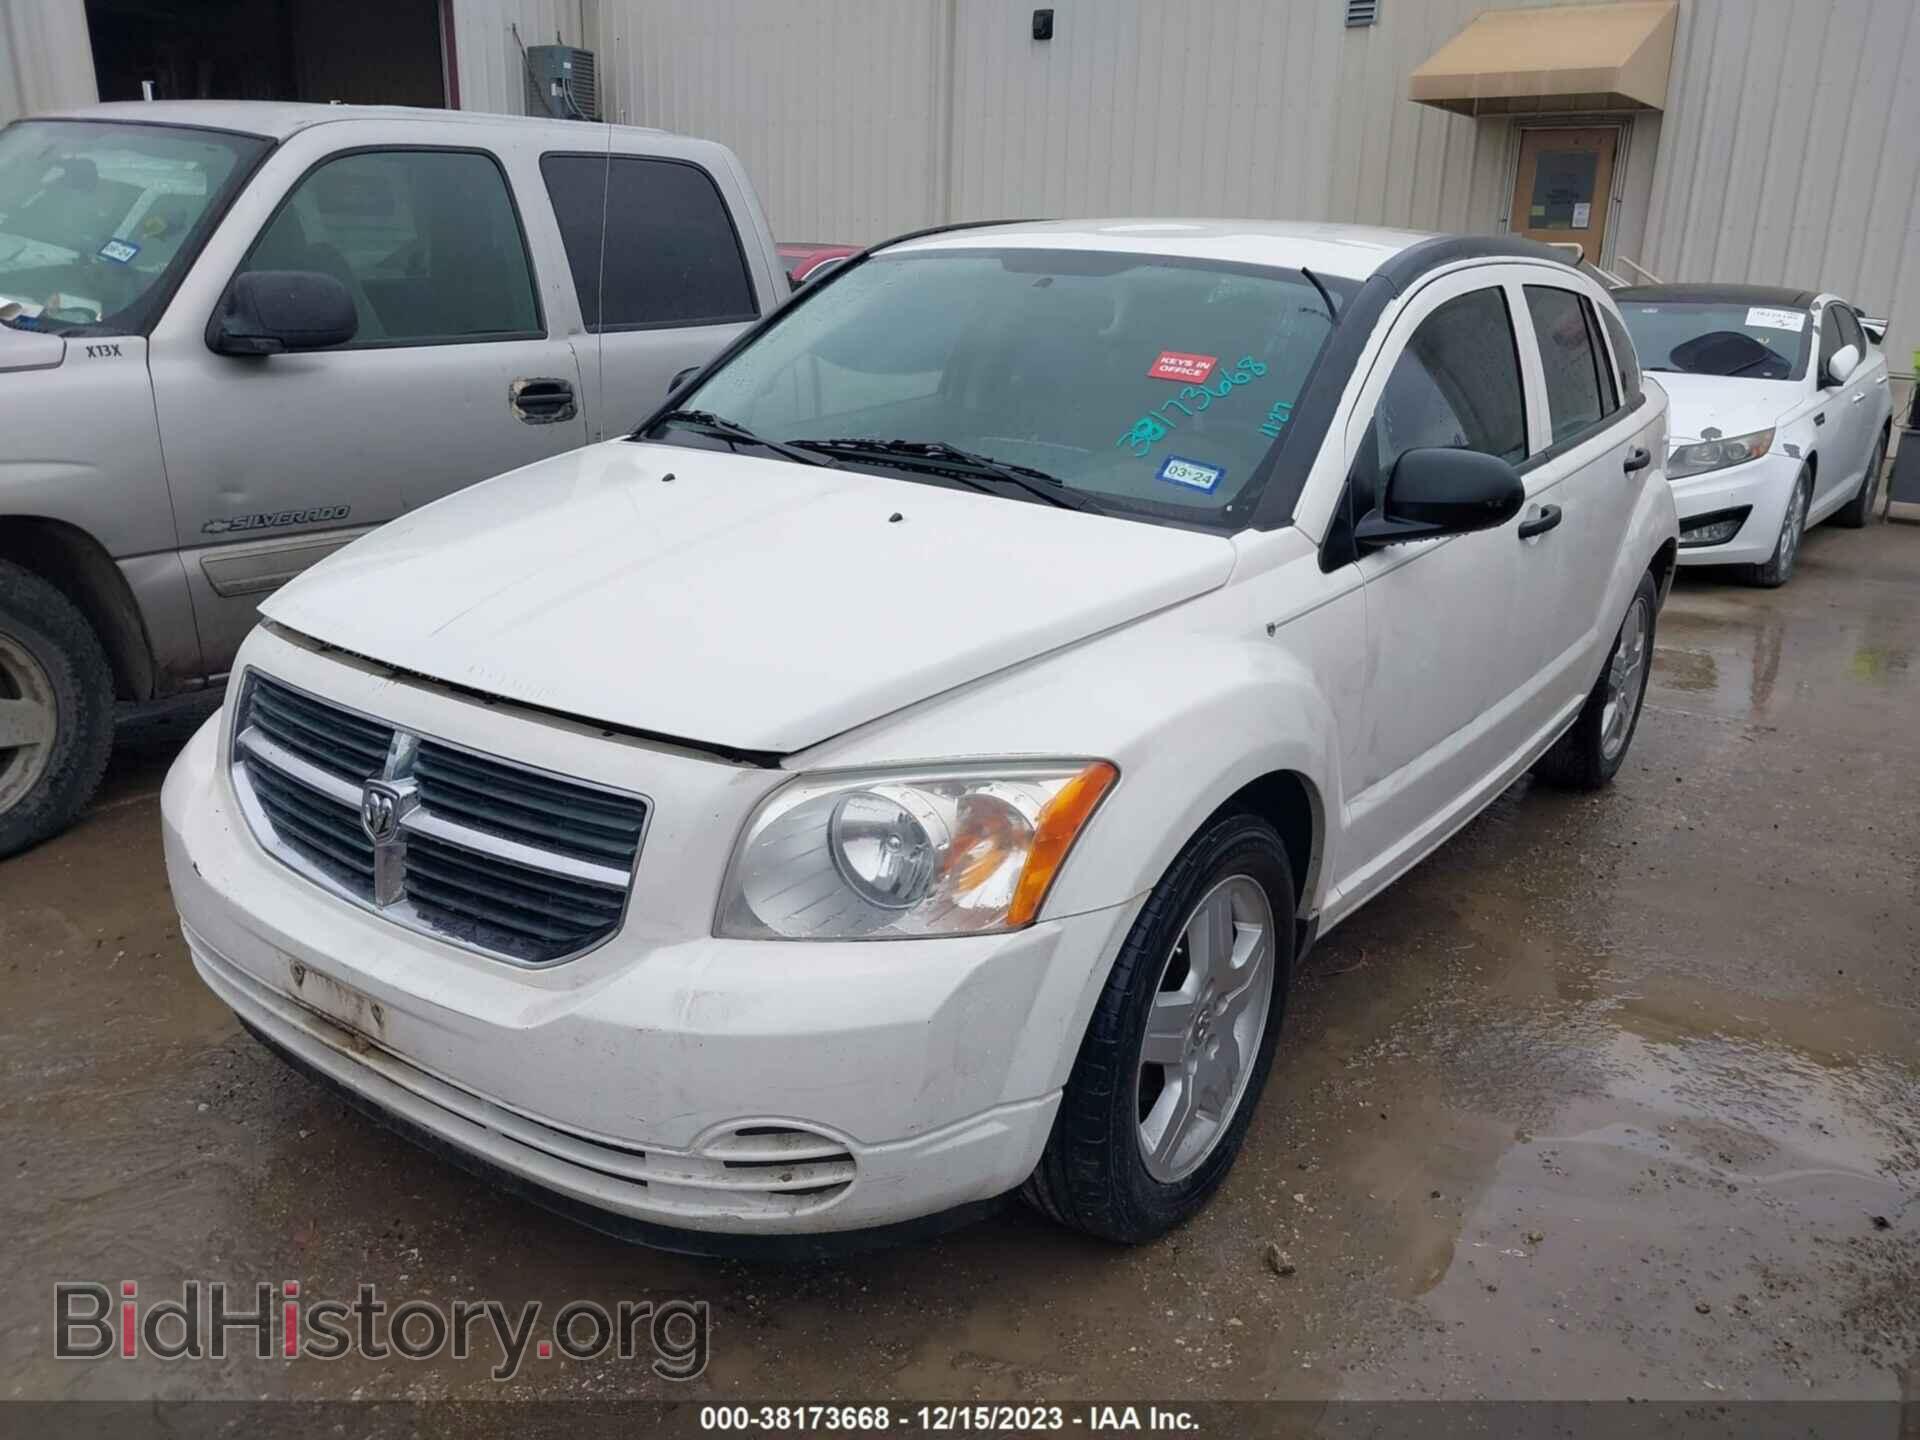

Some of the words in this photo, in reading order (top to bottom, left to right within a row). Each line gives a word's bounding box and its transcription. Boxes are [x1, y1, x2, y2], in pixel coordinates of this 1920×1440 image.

[86, 344, 122, 358] X13X
[1160, 364, 1202, 376] OFFICE
[1161, 357, 1193, 367] KEYS
[1196, 361, 1211, 369] IN
[1116, 355, 1268, 457] 38173668
[229, 505, 351, 531] SILVERADO
